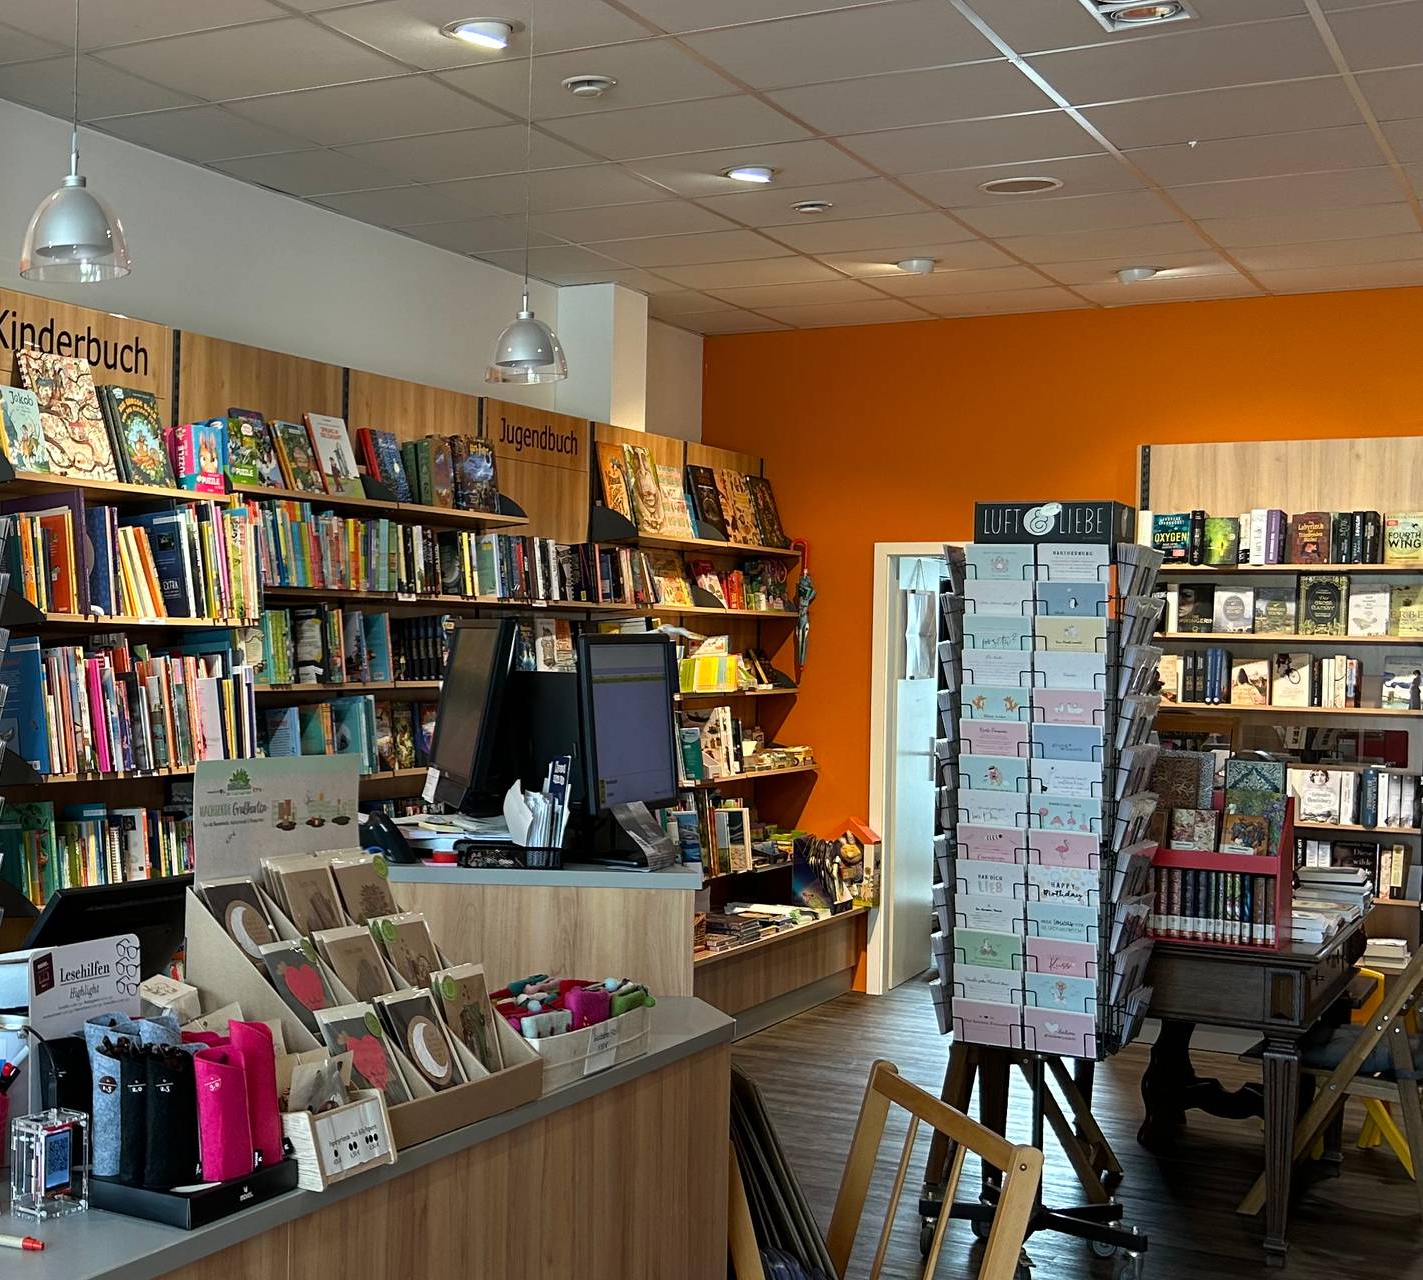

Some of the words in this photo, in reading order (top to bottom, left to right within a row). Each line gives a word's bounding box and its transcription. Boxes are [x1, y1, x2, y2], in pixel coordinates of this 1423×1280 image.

[499, 418, 578, 455] Jugendbuch
[984, 508, 1021, 534] LUFT
[1059, 507, 1104, 534] LIEBE
[1155, 532, 1187, 542] OXYGEN
[1388, 532, 1421, 540] FOURTH
[1389, 539, 1421, 548] WING
[1043, 889, 1083, 901] Birthday
[60, 961, 110, 983] Lesehilfen
[69, 984, 99, 1001] Highlight
